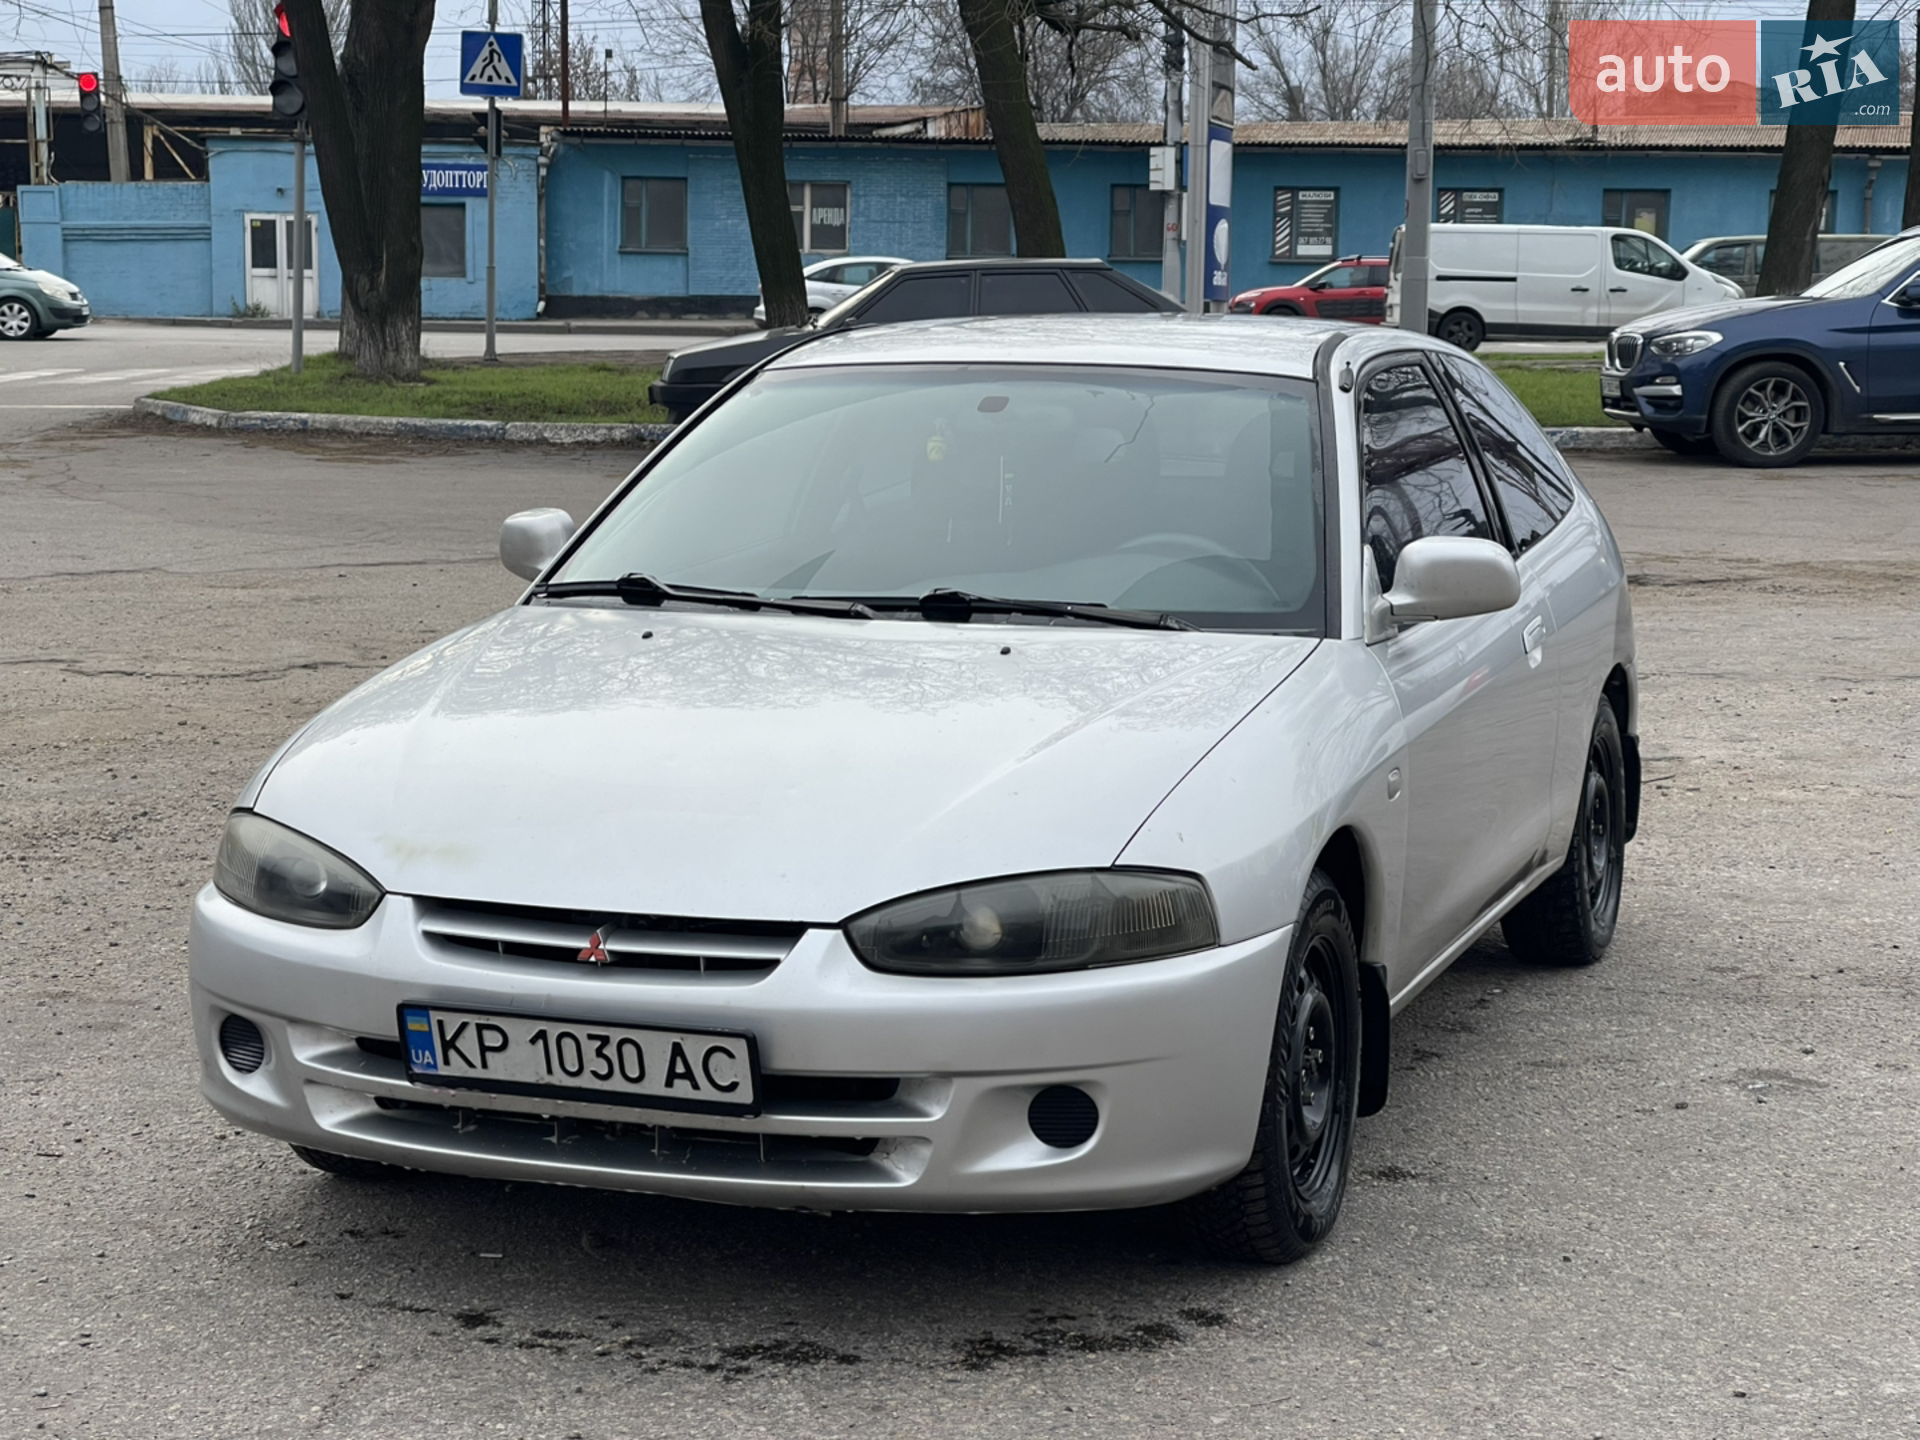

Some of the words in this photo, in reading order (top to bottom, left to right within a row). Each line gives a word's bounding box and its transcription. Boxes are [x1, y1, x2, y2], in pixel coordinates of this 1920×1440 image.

[421, 169, 488, 191] УДОПТТОРГ
[812, 208, 845, 226] АРЕНДА
[412, 1048, 434, 1065] UA
[436, 1019, 509, 1070] KP
[528, 1029, 646, 1084] 1030
[664, 1041, 740, 1093] AC
